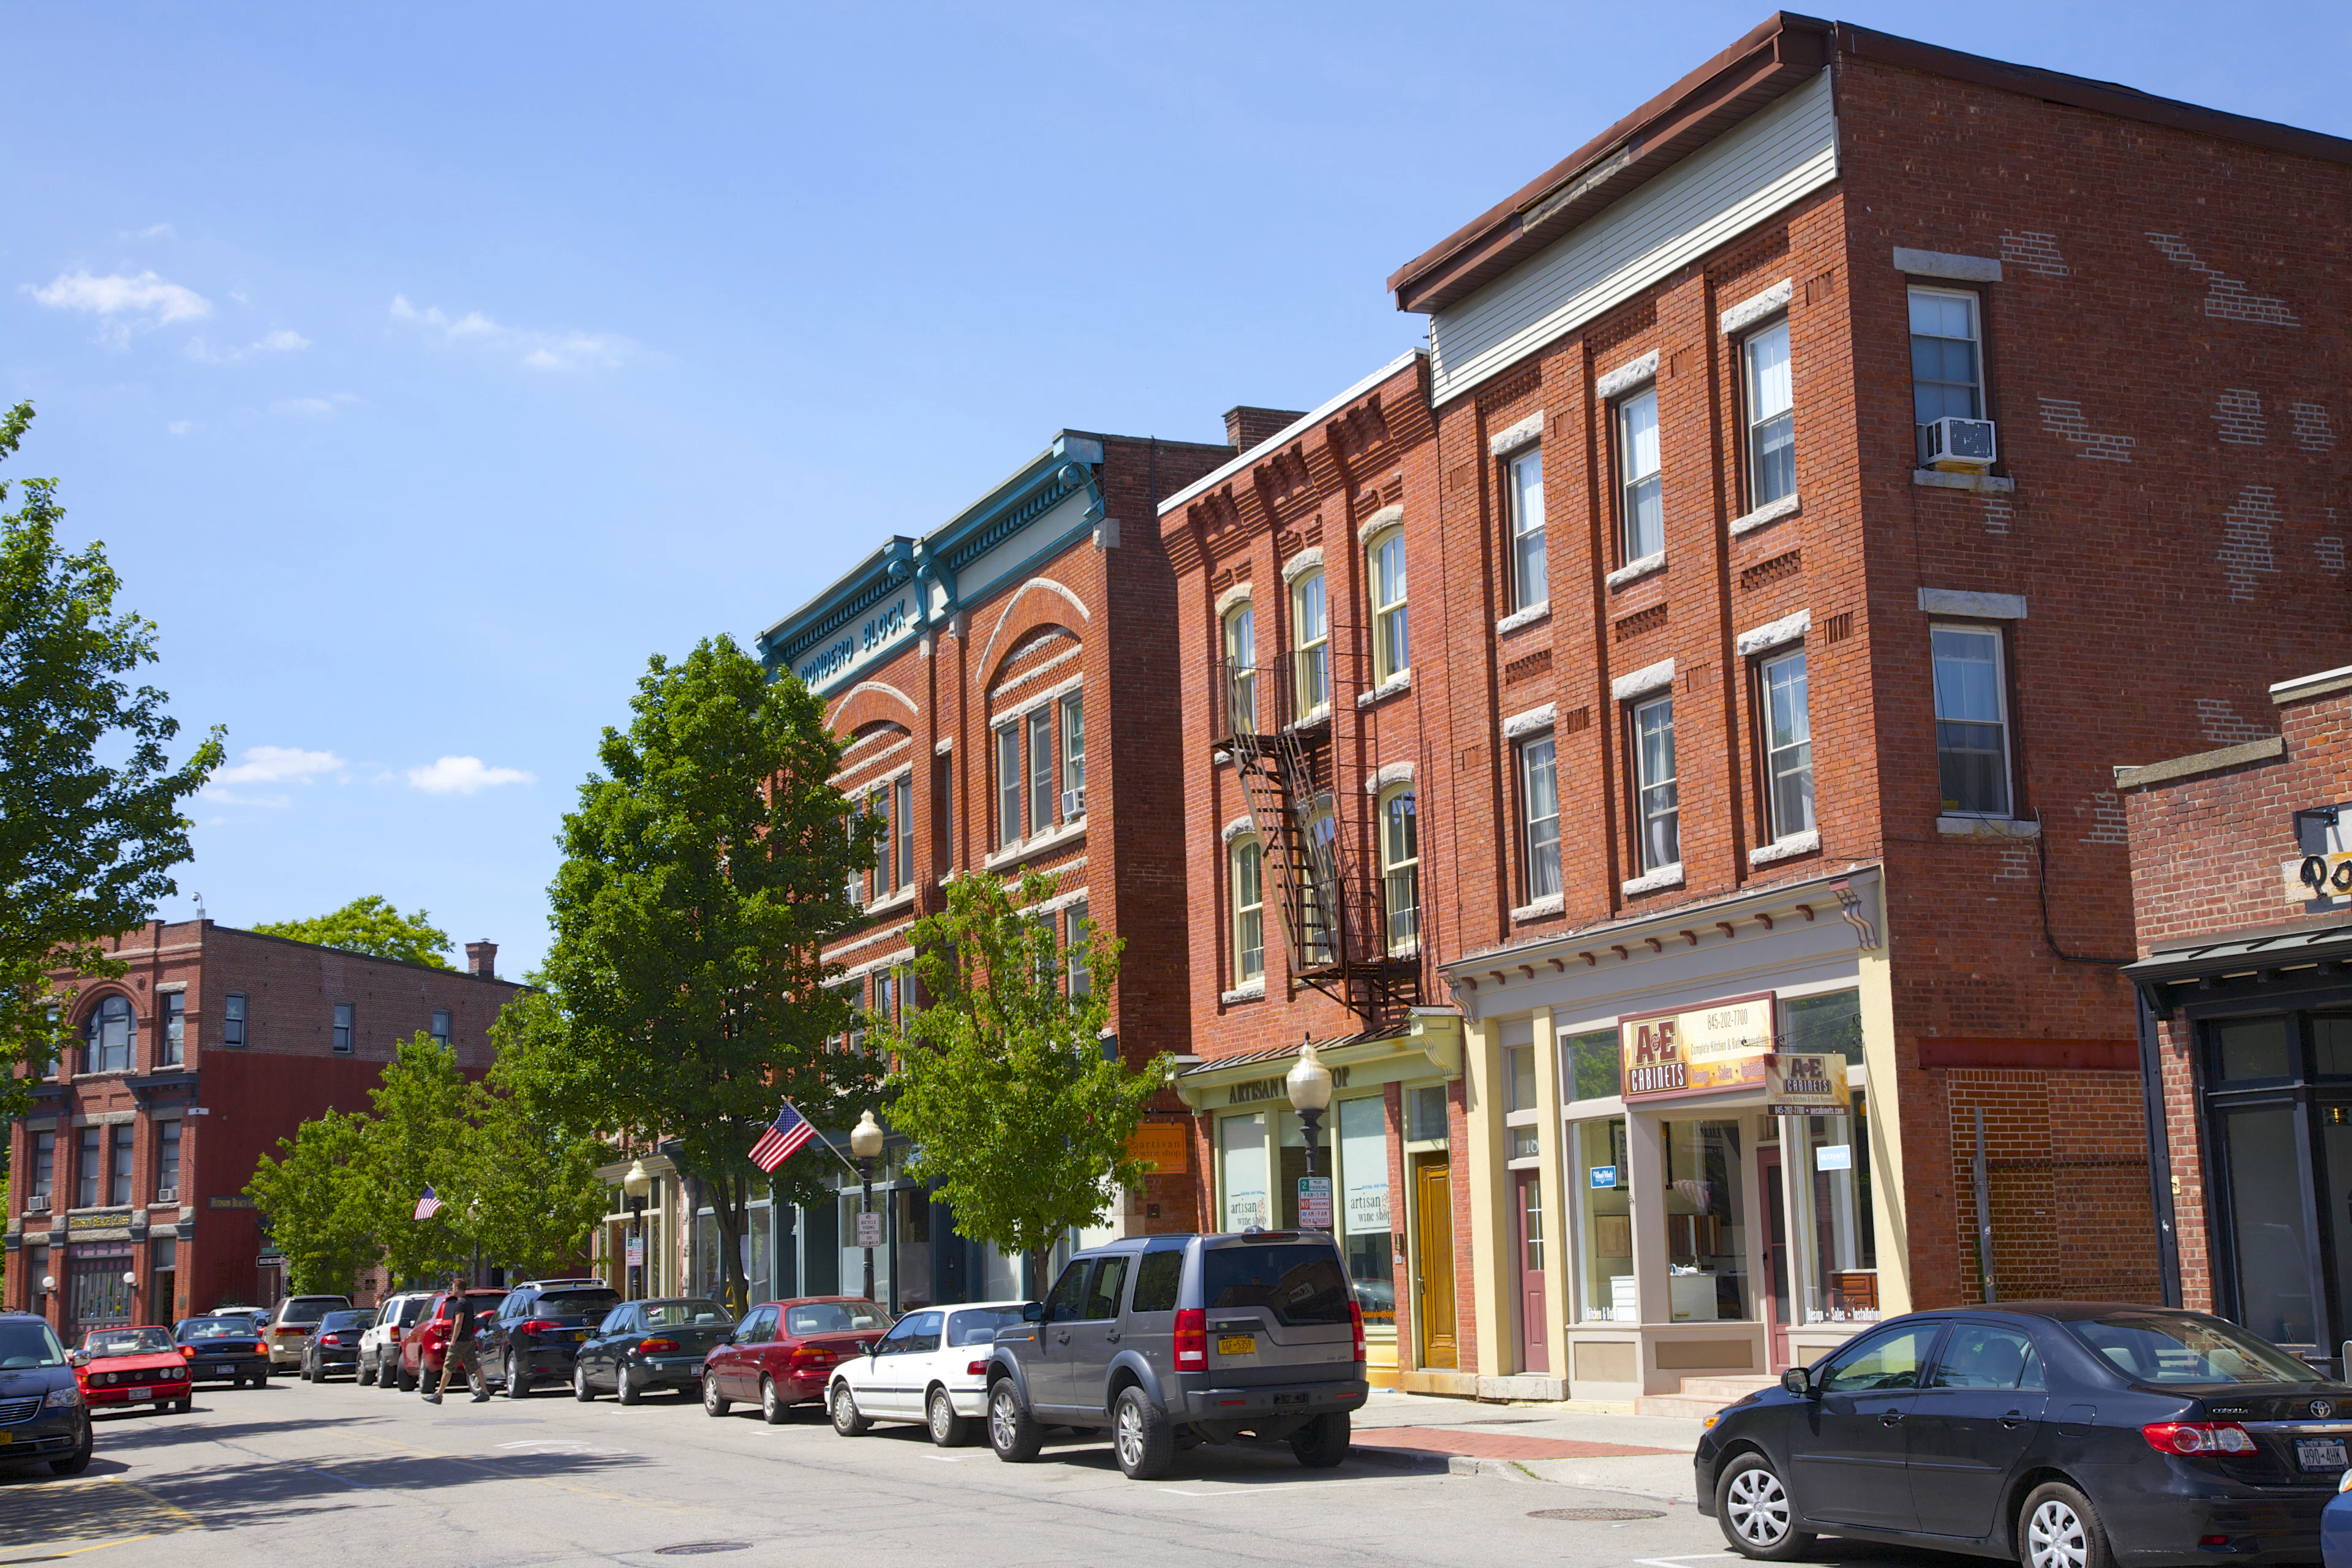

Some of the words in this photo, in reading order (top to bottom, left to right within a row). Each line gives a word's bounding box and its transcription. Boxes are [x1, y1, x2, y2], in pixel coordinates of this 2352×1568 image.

[801, 636, 853, 685] DONDERO
[863, 599, 905, 650] BLOCK
[1708, 1009, 1748, 1030] 845-202-7700
[1691, 1043, 1709, 1057] Complete
[1711, 1039, 1726, 1052] Kitchen
[1727, 1038, 1731, 1050] &
[1331, 1066, 1350, 1088] OP
[1632, 1063, 1683, 1092] CABINETS
[1691, 1067, 1709, 1085] Design
[1717, 1064, 1732, 1080] Sales
[1229, 1078, 1279, 1104] ARTISAN
[1787, 1080, 1828, 1092] CABINETS
[1774, 1106, 1804, 1114] 845-202-7700
[1810, 1106, 1845, 1115] aecabinets.com
[1139, 1139, 1180, 1148] artisan
[1162, 1148, 1180, 1158] shop
[211, 1197, 231, 1207] HUDSON
[232, 1198, 247, 1207] BEACH
[1231, 1198, 1257, 1214] artisan
[1351, 1192, 1381, 1209] artisan
[70, 1216, 92, 1229] HUDSON
[93, 1216, 110, 1226] BEACH
[111, 1214, 129, 1226] GLASS
[1238, 1214, 1251, 1226] wine
[1253, 1213, 1267, 1227] shop
[1359, 1209, 1374, 1223] wine
[1376, 1208, 1390, 1224] shop
[1586, 1307, 1602, 1321] Kitchen
[1602, 1306, 1606, 1320] &
[1807, 1307, 1823, 1323] Design
[1831, 1306, 1845, 1321] Sales
